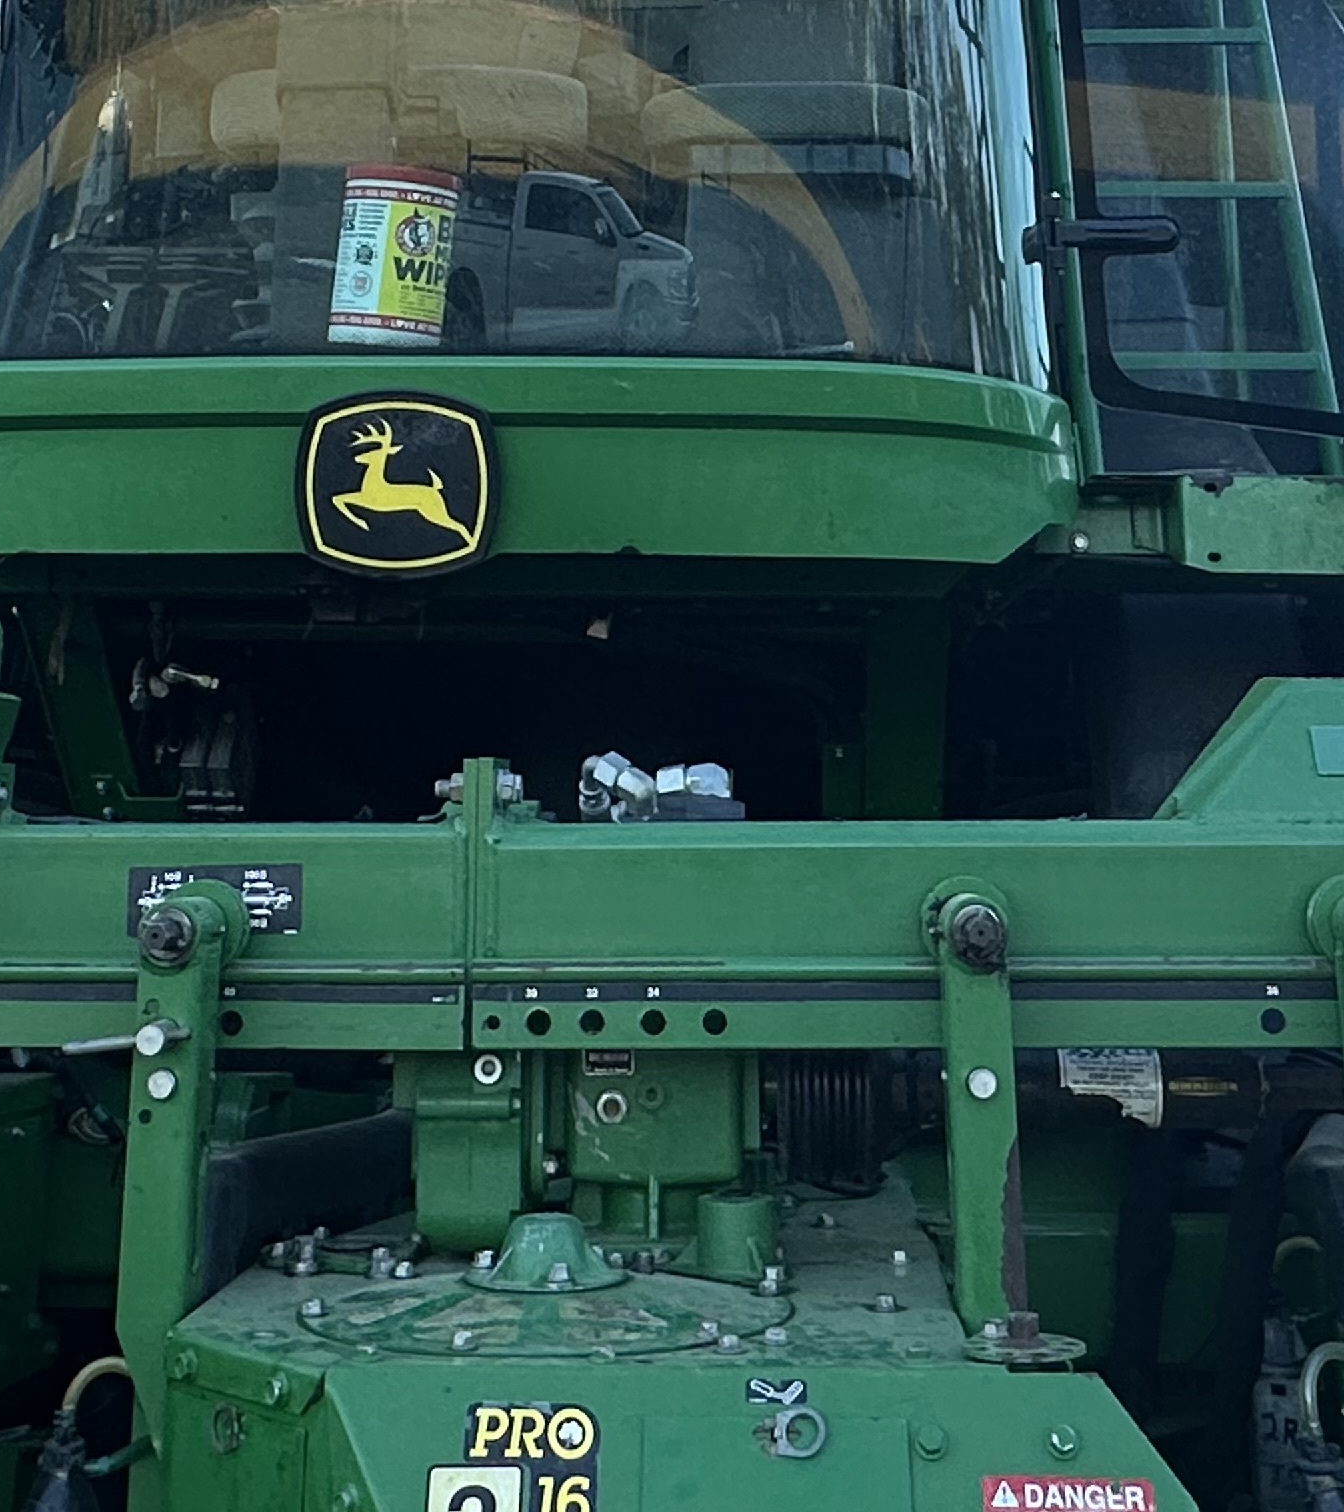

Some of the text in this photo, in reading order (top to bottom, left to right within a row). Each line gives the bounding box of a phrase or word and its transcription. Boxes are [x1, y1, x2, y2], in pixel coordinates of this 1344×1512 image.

[469, 1407, 595, 1460] PRO
[538, 1476, 591, 1512] 16
[1024, 1482, 1146, 1511] DANGER
